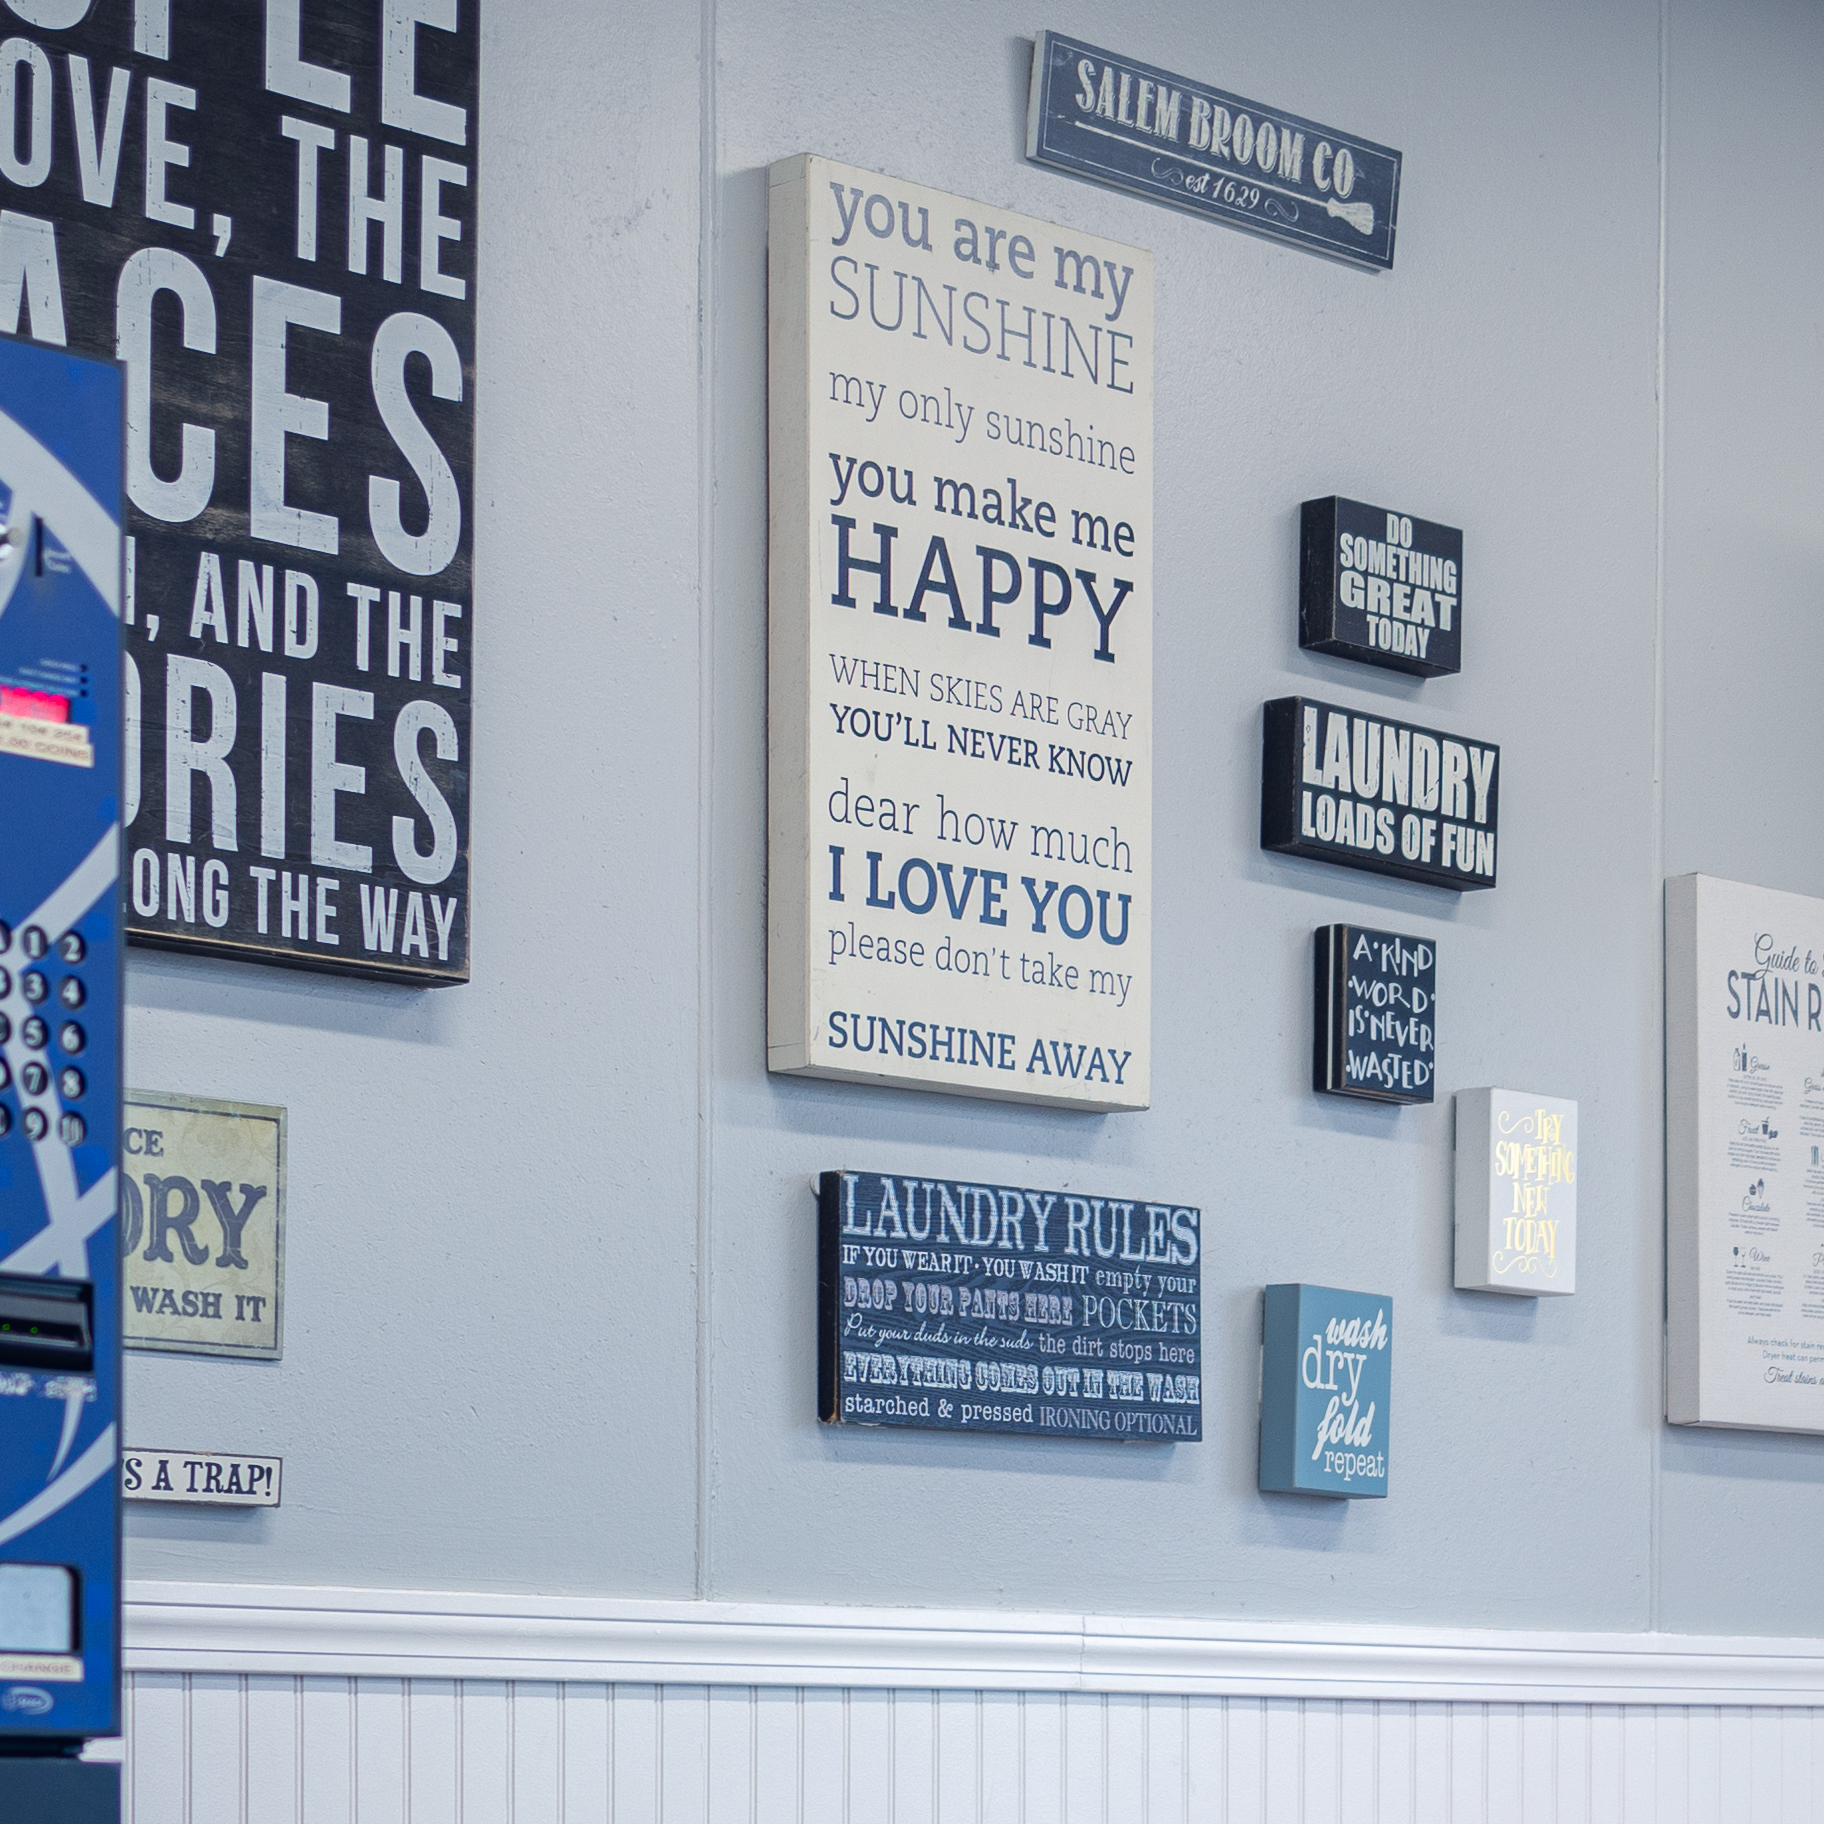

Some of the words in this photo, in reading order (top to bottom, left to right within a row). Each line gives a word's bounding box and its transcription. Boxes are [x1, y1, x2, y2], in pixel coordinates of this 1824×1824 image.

[1076, 58, 1181, 142] SALEM
[1189, 95, 1304, 185] BROOM
[1313, 139, 1357, 198] CO
[279, 115, 468, 301] THE
[1185, 172, 1209, 192] est
[1212, 177, 1260, 210] 1629
[829, 181, 932, 246] you
[954, 217, 1035, 279] are
[1054, 245, 1134, 322] my
[830, 255, 1134, 394] SUNSHINE
[829, 371, 886, 422] my
[899, 387, 974, 443] only
[986, 410, 1135, 474] sunshine
[829, 452, 916, 506] you
[934, 478, 1056, 538] make
[1072, 509, 1135, 557] me
[1386, 513, 1412, 548] DO
[831, 514, 1134, 663] HAPPY
[1340, 533, 1457, 595] SOMETHING
[188, 551, 321, 662] AND
[346, 582, 464, 689] THE
[1340, 570, 1457, 631] GREAT
[1366, 614, 1430, 658] TODAY
[829, 654, 920, 697] WHEN
[930, 674, 1002, 714] SKIES
[1010, 690, 1059, 725] ARE
[1067, 702, 1132, 740] GRAY
[829, 703, 936, 750] YOU'LL
[948, 724, 1039, 770] NEVER
[1049, 744, 1133, 787] KNOW
[1302, 705, 1495, 824] LAUNDRY
[828, 777, 919, 835] dear
[937, 795, 1018, 851] how
[1031, 826, 1132, 872] much
[1301, 790, 1394, 856] LOADS
[1401, 814, 1436, 863] OF
[1441, 823, 1494, 876] FUN
[250, 866, 340, 945] THE
[359, 883, 457, 961] WAY
[828, 845, 844, 901] I
[866, 850, 1007, 927] LOVE
[1021, 876, 1132, 946] YOU
[828, 922, 924, 966] please
[935, 936, 1010, 980] don't
[1020, 952, 1079, 990] take
[1089, 969, 1132, 1008] my
[1381, 938, 1433, 978] KIND
[1754, 932, 1799, 980] Guide
[1804, 950, 1818, 975] to
[1727, 969, 1799, 1028] STAIN
[828, 1011, 1015, 1070] SUNSHINE
[1026, 1039, 1132, 1085] AWAY
[1371, 1009, 1434, 1053] NEVER
[1348, 1053, 1430, 1090] WASTED
[1533, 1108, 1565, 1146] TRY
[1495, 1140, 1575, 1186] SOMETHING
[843, 1174, 1057, 1252] LAUNDRY
[1064, 1199, 1198, 1265] RULES
[1512, 1181, 1550, 1218] NEW
[1502, 1216, 1559, 1259] TODAY
[843, 1245, 860, 1264] IF
[863, 1249, 897, 1268] YOU
[902, 1250, 952, 1273] WEAR
[953, 1256, 973, 1274] IT
[983, 1258, 1016, 1278] YOU
[1019, 1261, 1070, 1283] WASH
[1071, 1266, 1089, 1284] IT
[1095, 1266, 1152, 1298] empty
[1157, 1277, 1196, 1297] your
[130, 1286, 222, 1319] WASH
[235, 1295, 266, 1322] IT
[844, 1277, 897, 1311] DROP
[902, 1282, 954, 1315] YOUR
[959, 1287, 1020, 1322] PANTS
[1025, 1292, 1072, 1325] HERE
[1082, 1295, 1196, 1335] POCKETS
[1326, 1309, 1388, 1350] wash
[844, 1313, 876, 1337] Put
[875, 1325, 912, 1347] your
[914, 1323, 950, 1343] duds
[973, 1329, 997, 1347] the
[1000, 1331, 1034, 1350] suds
[1039, 1334, 1065, 1354] the
[1072, 1336, 1102, 1357] dirt
[1110, 1342, 1152, 1364] stops
[1159, 1342, 1194, 1363] here
[844, 1351, 972, 1390] EVERYTHING
[976, 1361, 1039, 1394] COMES
[1043, 1365, 1080, 1397] OUT
[1082, 1368, 1103, 1398] IN
[1107, 1370, 1144, 1401] THE
[1147, 1372, 1200, 1404] WASH
[1302, 1334, 1368, 1406] dry
[1795, 1371, 1817, 1385] stains
[844, 1394, 930, 1417] starched
[937, 1400, 953, 1418] &
[961, 1403, 1033, 1423] pressed
[1040, 1406, 1111, 1432] IRONING
[1115, 1412, 1197, 1436] OPTIONAL
[1312, 1396, 1375, 1461] fold
[152, 1460, 174, 1491] A
[183, 1459, 273, 1497] TRAP!
[1324, 1447, 1385, 1481] repeat
